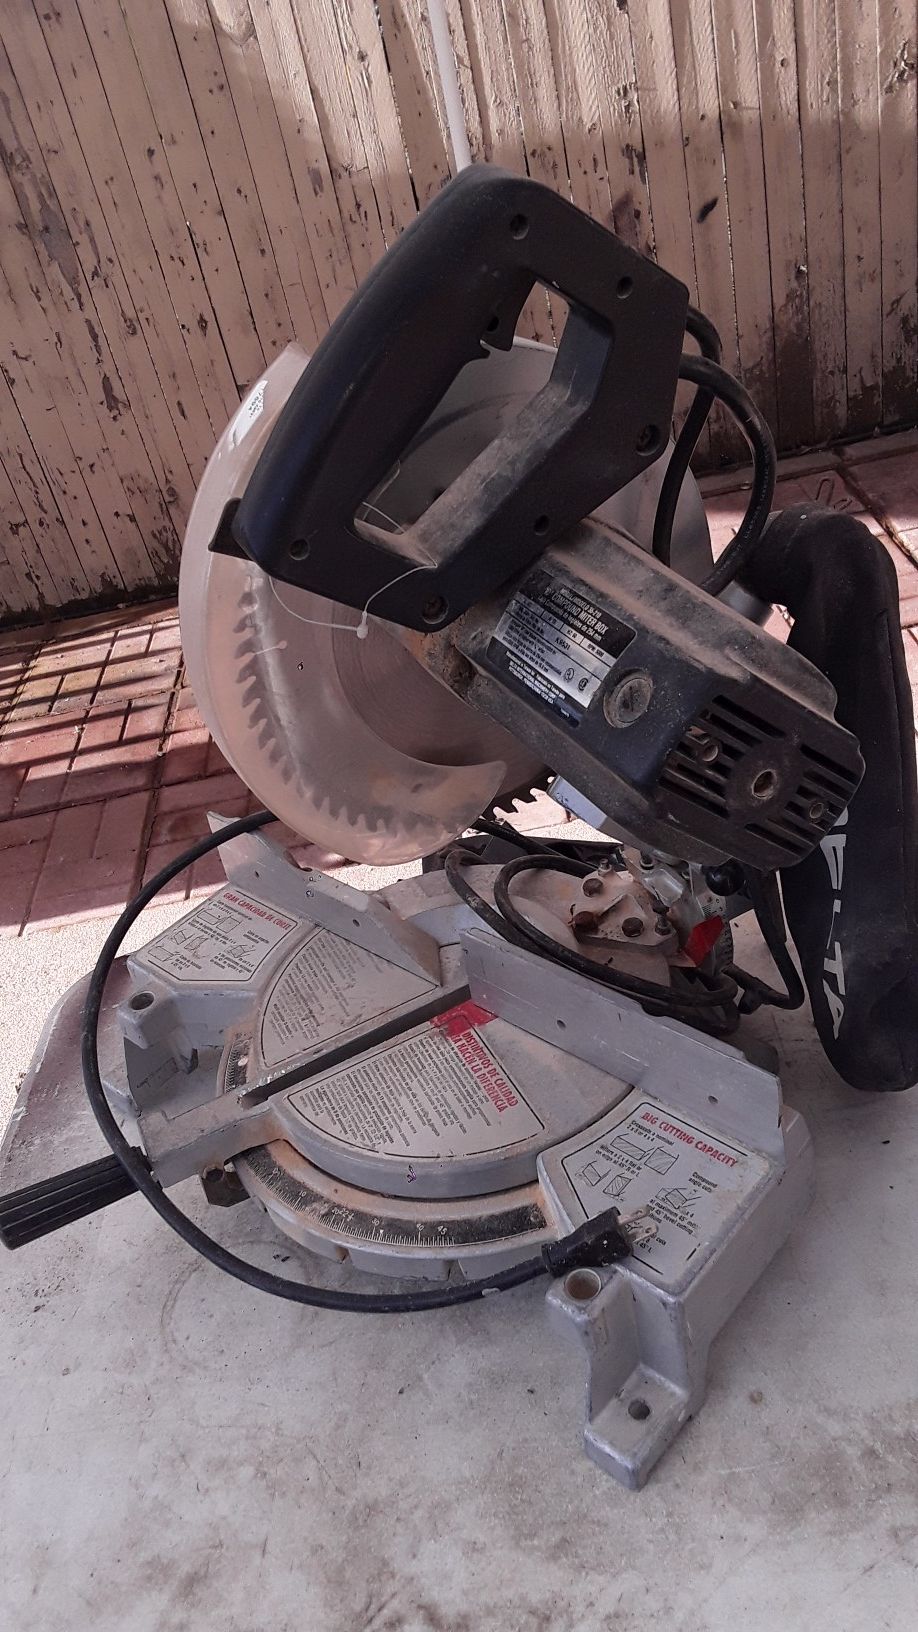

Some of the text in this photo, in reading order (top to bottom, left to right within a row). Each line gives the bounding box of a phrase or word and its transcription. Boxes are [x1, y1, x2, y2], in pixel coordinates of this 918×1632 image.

[551, 593, 580, 615] COMPOUND
[578, 610, 596, 626] MITER
[594, 621, 608, 634] BOX
[223, 891, 238, 903] GRAN
[238, 899, 265, 918] CAPACIDAD
[264, 913, 273, 922] DE
[273, 917, 290, 931] CORTE
[457, 1042, 507, 1111] HACEN LA DIFERENCIA
[462, 1031, 492, 1069] DISTINTIVOS
[487, 1067, 499, 1079] DE
[494, 1077, 518, 1107] CALIDAD
[641, 1111, 736, 1168] BIG CUTTING CAPACITY
[692, 1171, 717, 1188] Compound
[655, 1202, 678, 1217] maximum
[663, 1213, 676, 1224] bevel
